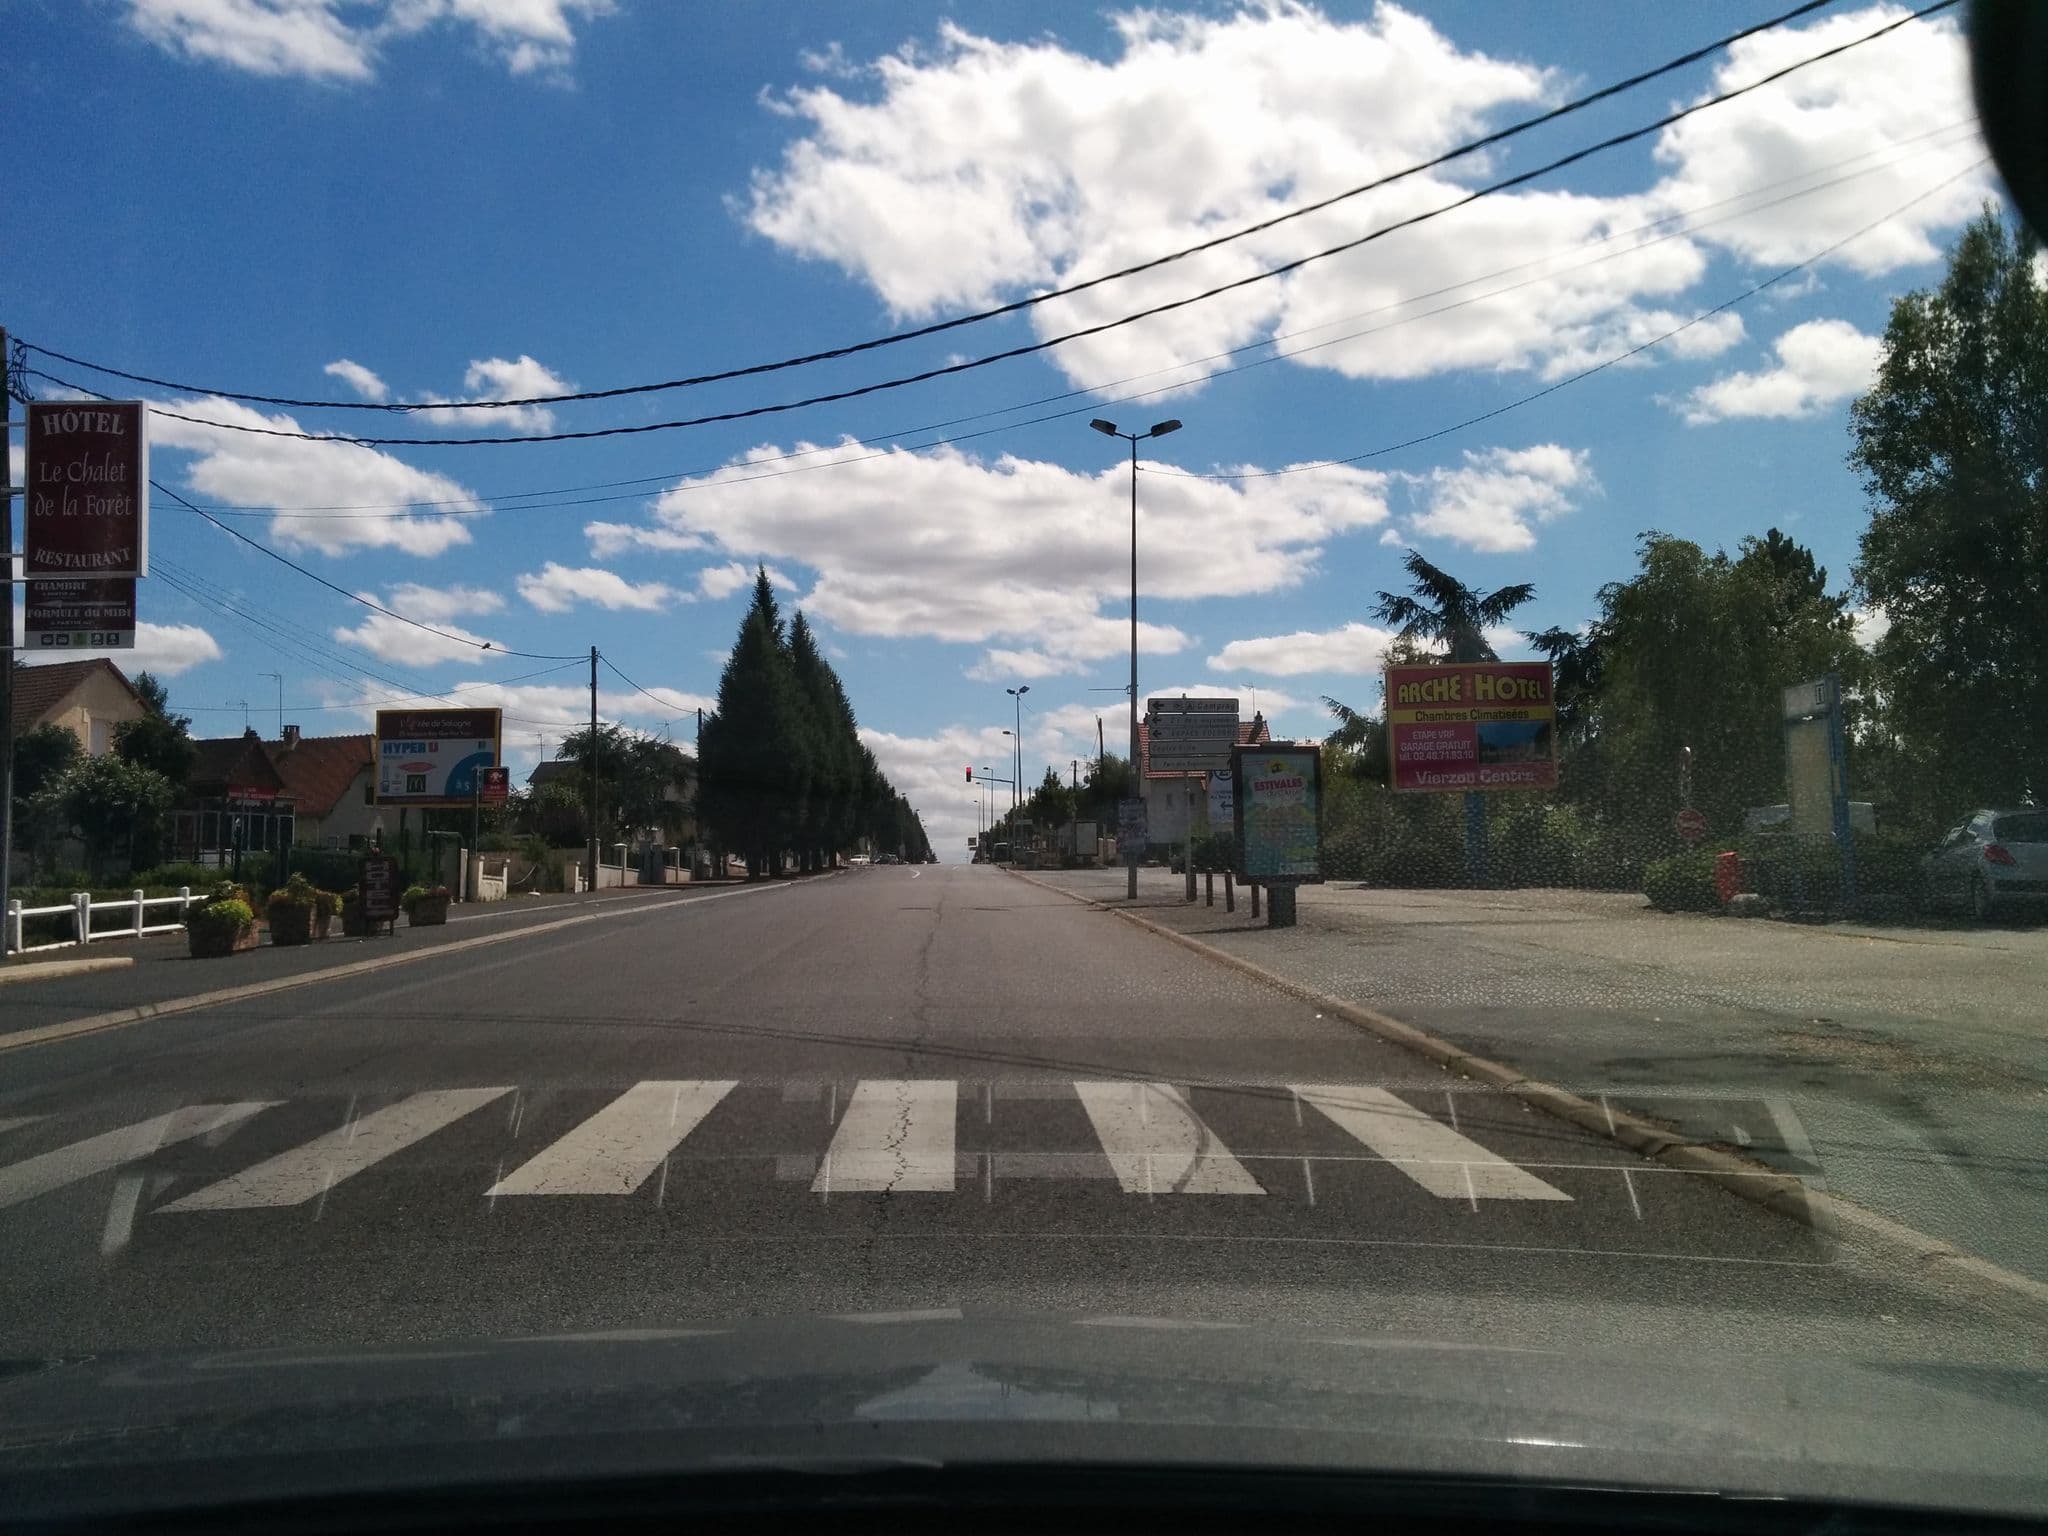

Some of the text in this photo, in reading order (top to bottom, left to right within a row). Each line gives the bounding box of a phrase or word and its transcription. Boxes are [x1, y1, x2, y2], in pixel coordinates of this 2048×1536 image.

[41, 409, 125, 436] HÔTEL
[40, 451, 127, 485] Le Chalet
[35, 485, 133, 517] de la Forêt
[33, 547, 131, 569] RESTAURANT
[1397, 673, 1545, 704] ARCHE HOTEL
[1415, 708, 1530, 721] Chambres Climatisées
[383, 742, 426, 754] HYPER
[1400, 740, 1472, 752] GARAGE GRATUIT
[1254, 778, 1303, 791] ESTIVALES
[1415, 769, 1536, 784] Vierzon Centre
